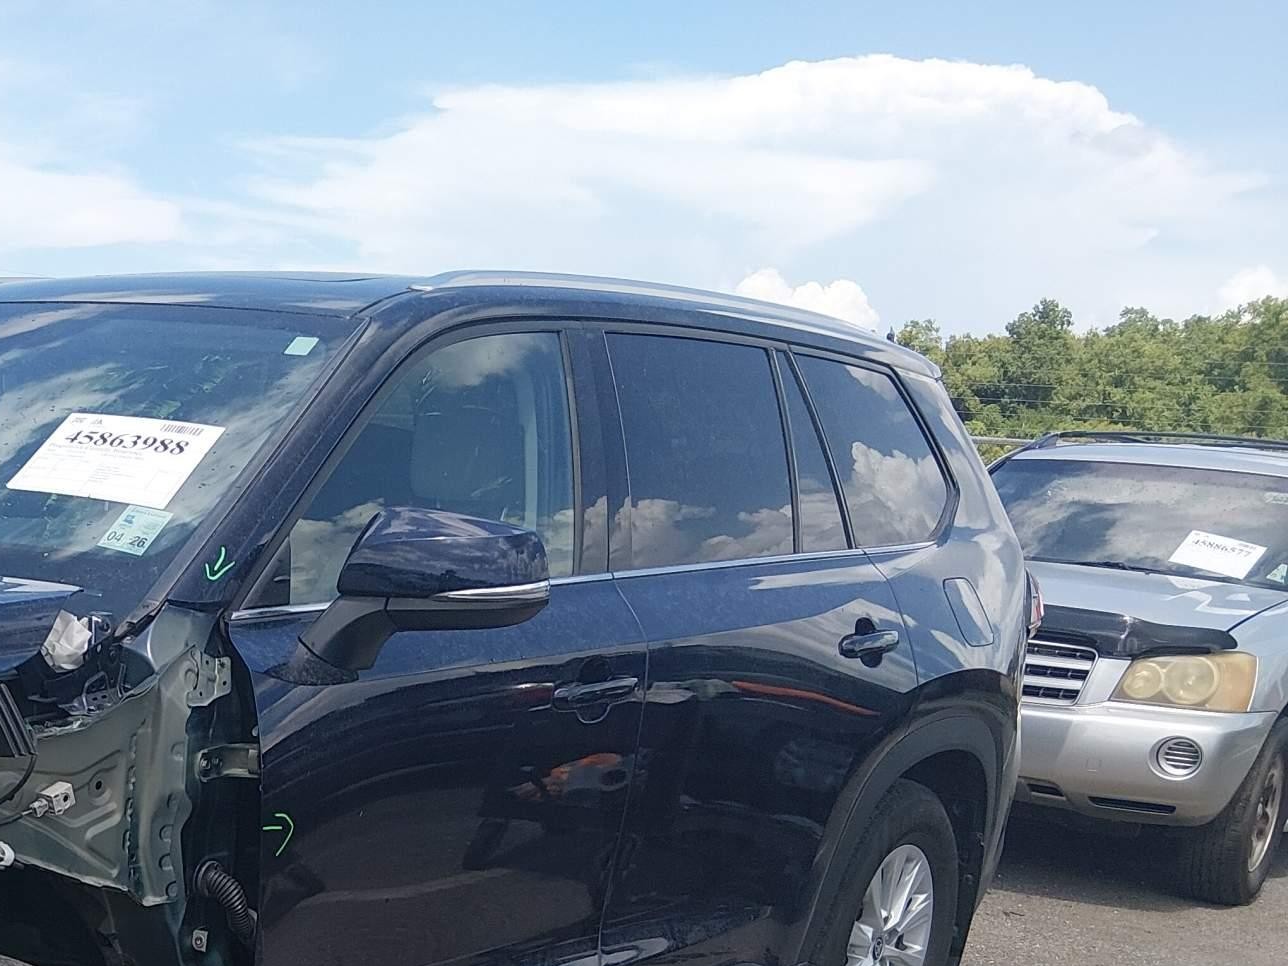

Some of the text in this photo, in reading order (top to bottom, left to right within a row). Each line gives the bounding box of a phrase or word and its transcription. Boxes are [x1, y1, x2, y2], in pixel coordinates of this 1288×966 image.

[65, 429, 190, 456] 45863988
[106, 530, 148, 548] 04 26
